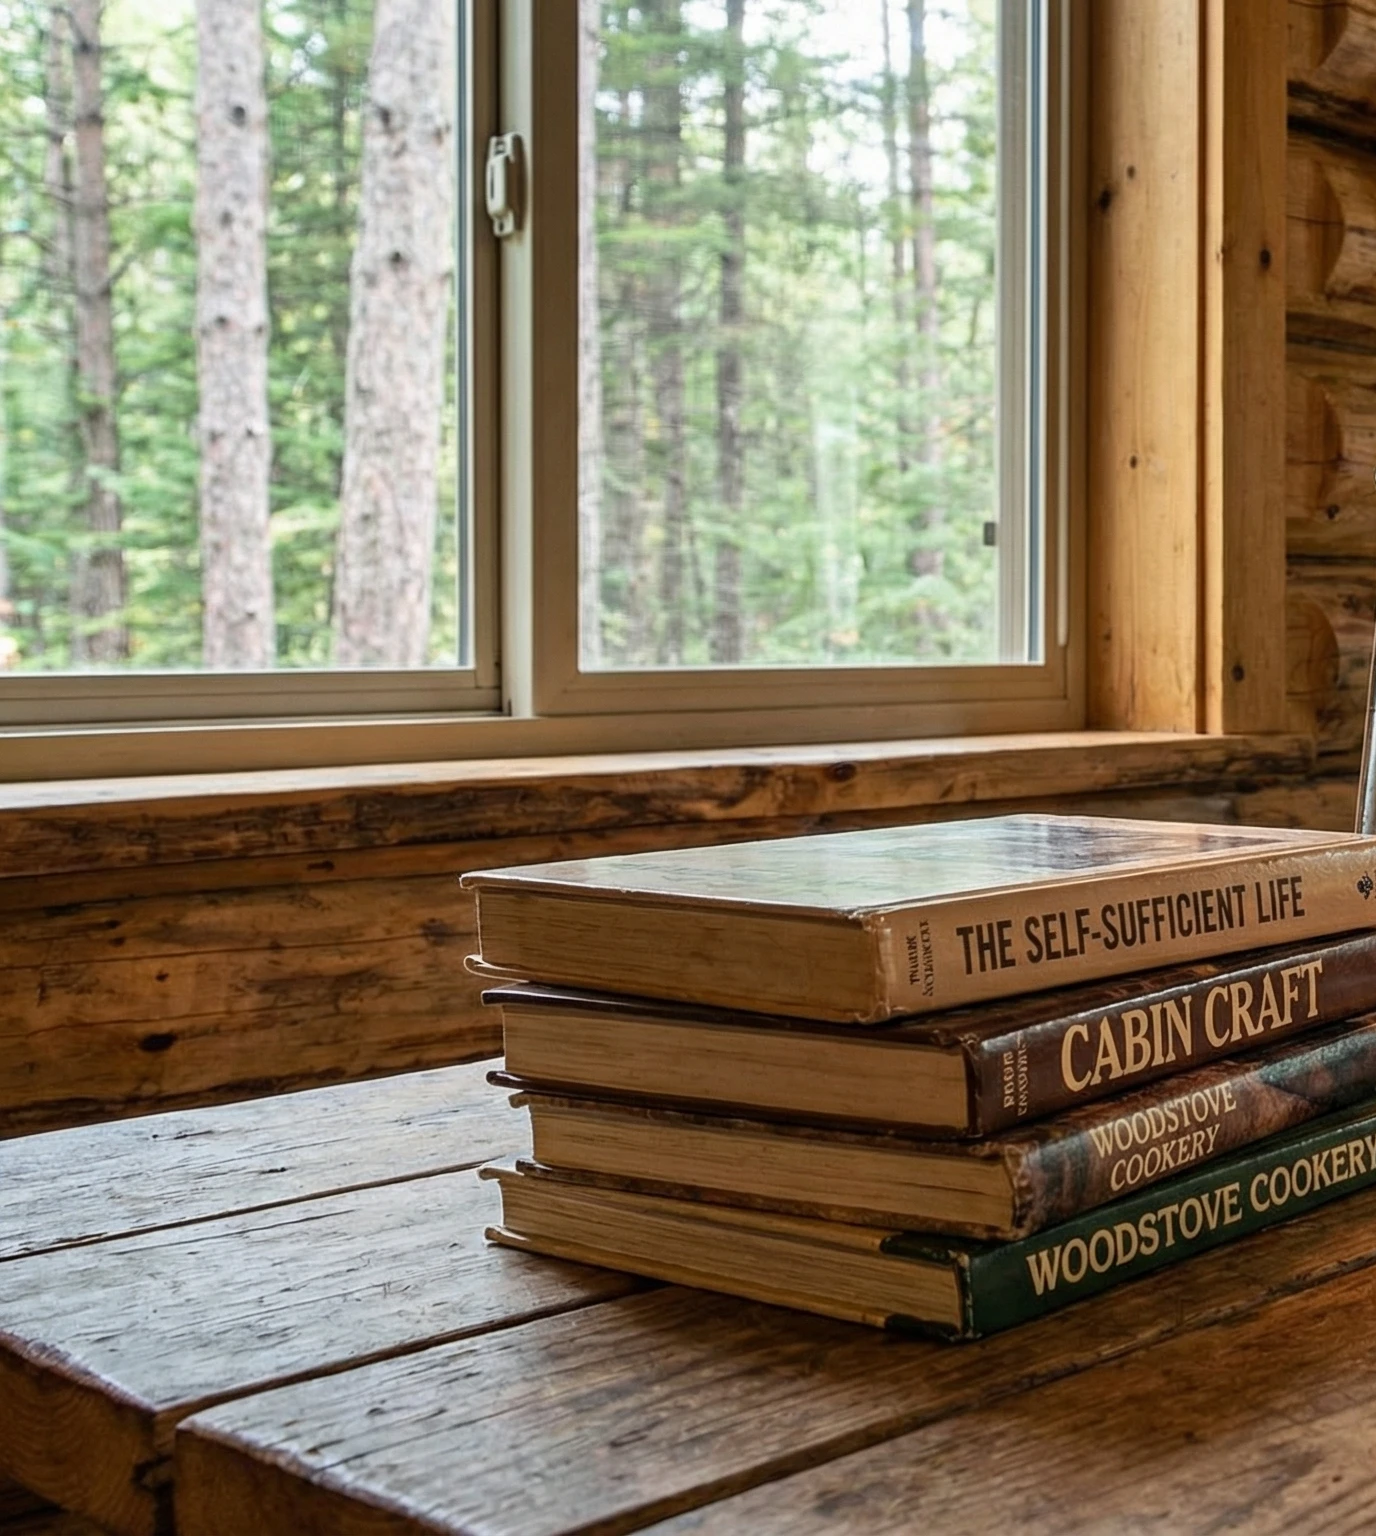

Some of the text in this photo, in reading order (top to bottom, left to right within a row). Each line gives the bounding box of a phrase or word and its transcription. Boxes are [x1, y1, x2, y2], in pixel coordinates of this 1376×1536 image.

[956, 920, 1016, 975] THE
[1025, 884, 1245, 964] SELF-SUFFICIENT
[1255, 876, 1305, 923] LIFE
[1061, 995, 1193, 1092] CABIN
[1204, 959, 1323, 1048] CRAFT
[1089, 1081, 1236, 1158] WOODSTOVE
[1110, 1124, 1220, 1191] COOKERY
[1026, 1182, 1242, 1296] WOODSTOVE
